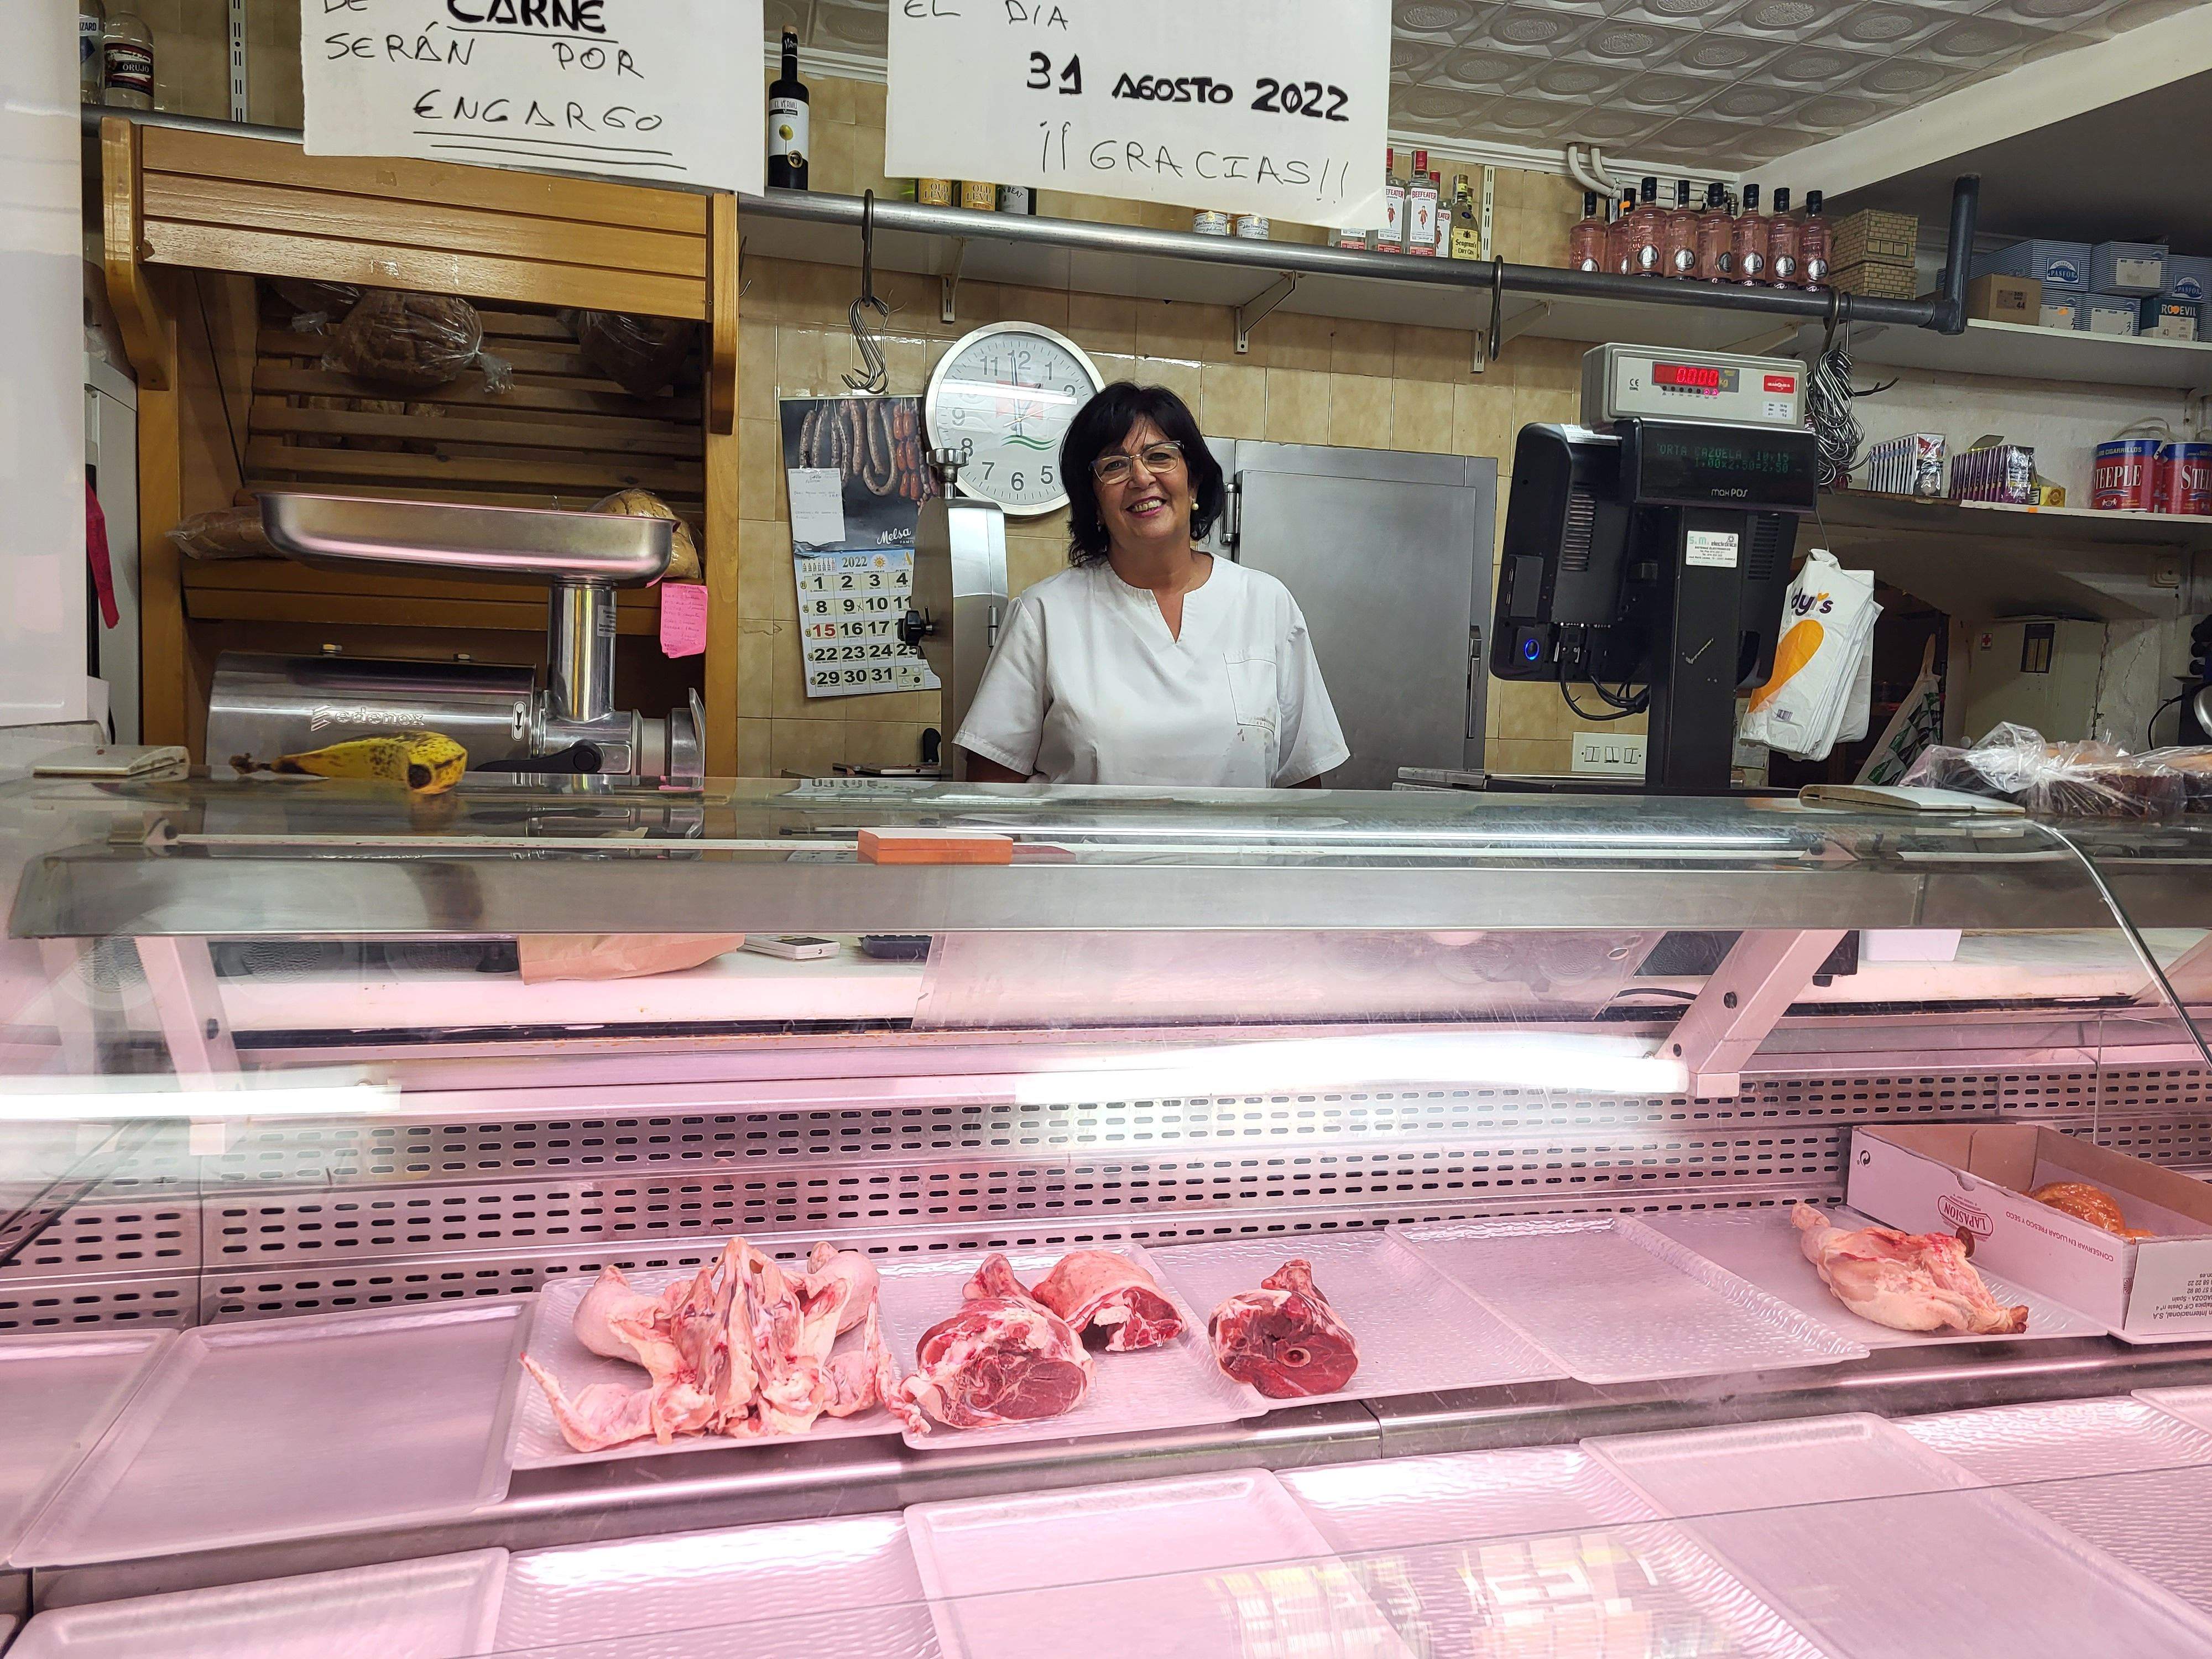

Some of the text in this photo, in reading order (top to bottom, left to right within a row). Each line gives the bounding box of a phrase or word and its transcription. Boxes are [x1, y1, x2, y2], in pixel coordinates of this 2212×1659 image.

[448, 0, 607, 33] CARNE
[324, 21, 645, 79] SERÁN POR
[122, 64, 150, 73] ORUJO
[1026, 51, 1349, 122] 31 AGOSTO 2022
[1007, 186, 1024, 199] BEAT
[1412, 190, 1437, 200] BEEFEATER
[2051, 269, 2076, 278] PASFOR
[979, 356, 998, 377] 11
[1008, 350, 1031, 370] 12
[1045, 361, 1052, 381] 1
[961, 437, 973, 457] 8
[982, 461, 995, 481] 7
[1040, 466, 1053, 484] 5
[2094, 465, 2142, 490] TEEPLE
[1011, 472, 1024, 491] 6
[876, 527, 912, 545] Melsa
[842, 556, 868, 568] 2022
[814, 576, 823, 590] 1
[841, 575, 854, 589] 2
[868, 573, 881, 587] 3
[896, 572, 909, 586] 4
[816, 600, 828, 614] 8
[843, 598, 855, 612] 9
[865, 597, 889, 611] 10
[812, 623, 836, 638] 15
[840, 622, 864, 636] 16
[867, 620, 890, 634] 17
[813, 647, 838, 661] 22
[841, 646, 866, 660] 23
[868, 644, 894, 658] 24
[816, 671, 841, 685] 29
[843, 669, 868, 684] 30
[870, 667, 893, 681] 31
[335, 707, 425, 726] edenox
[1944, 1201, 1986, 1230] LAPASION
[2006, 1211, 2021, 1223] SECO
[2026, 1220, 2048, 1234] FRESCO
[2048, 1229, 2068, 1243] LUGAR
[2068, 1238, 2077, 1246] EN
[2077, 1243, 2114, 1262] CONSERVAR
[2166, 1310, 2208, 1319] Internacional,
